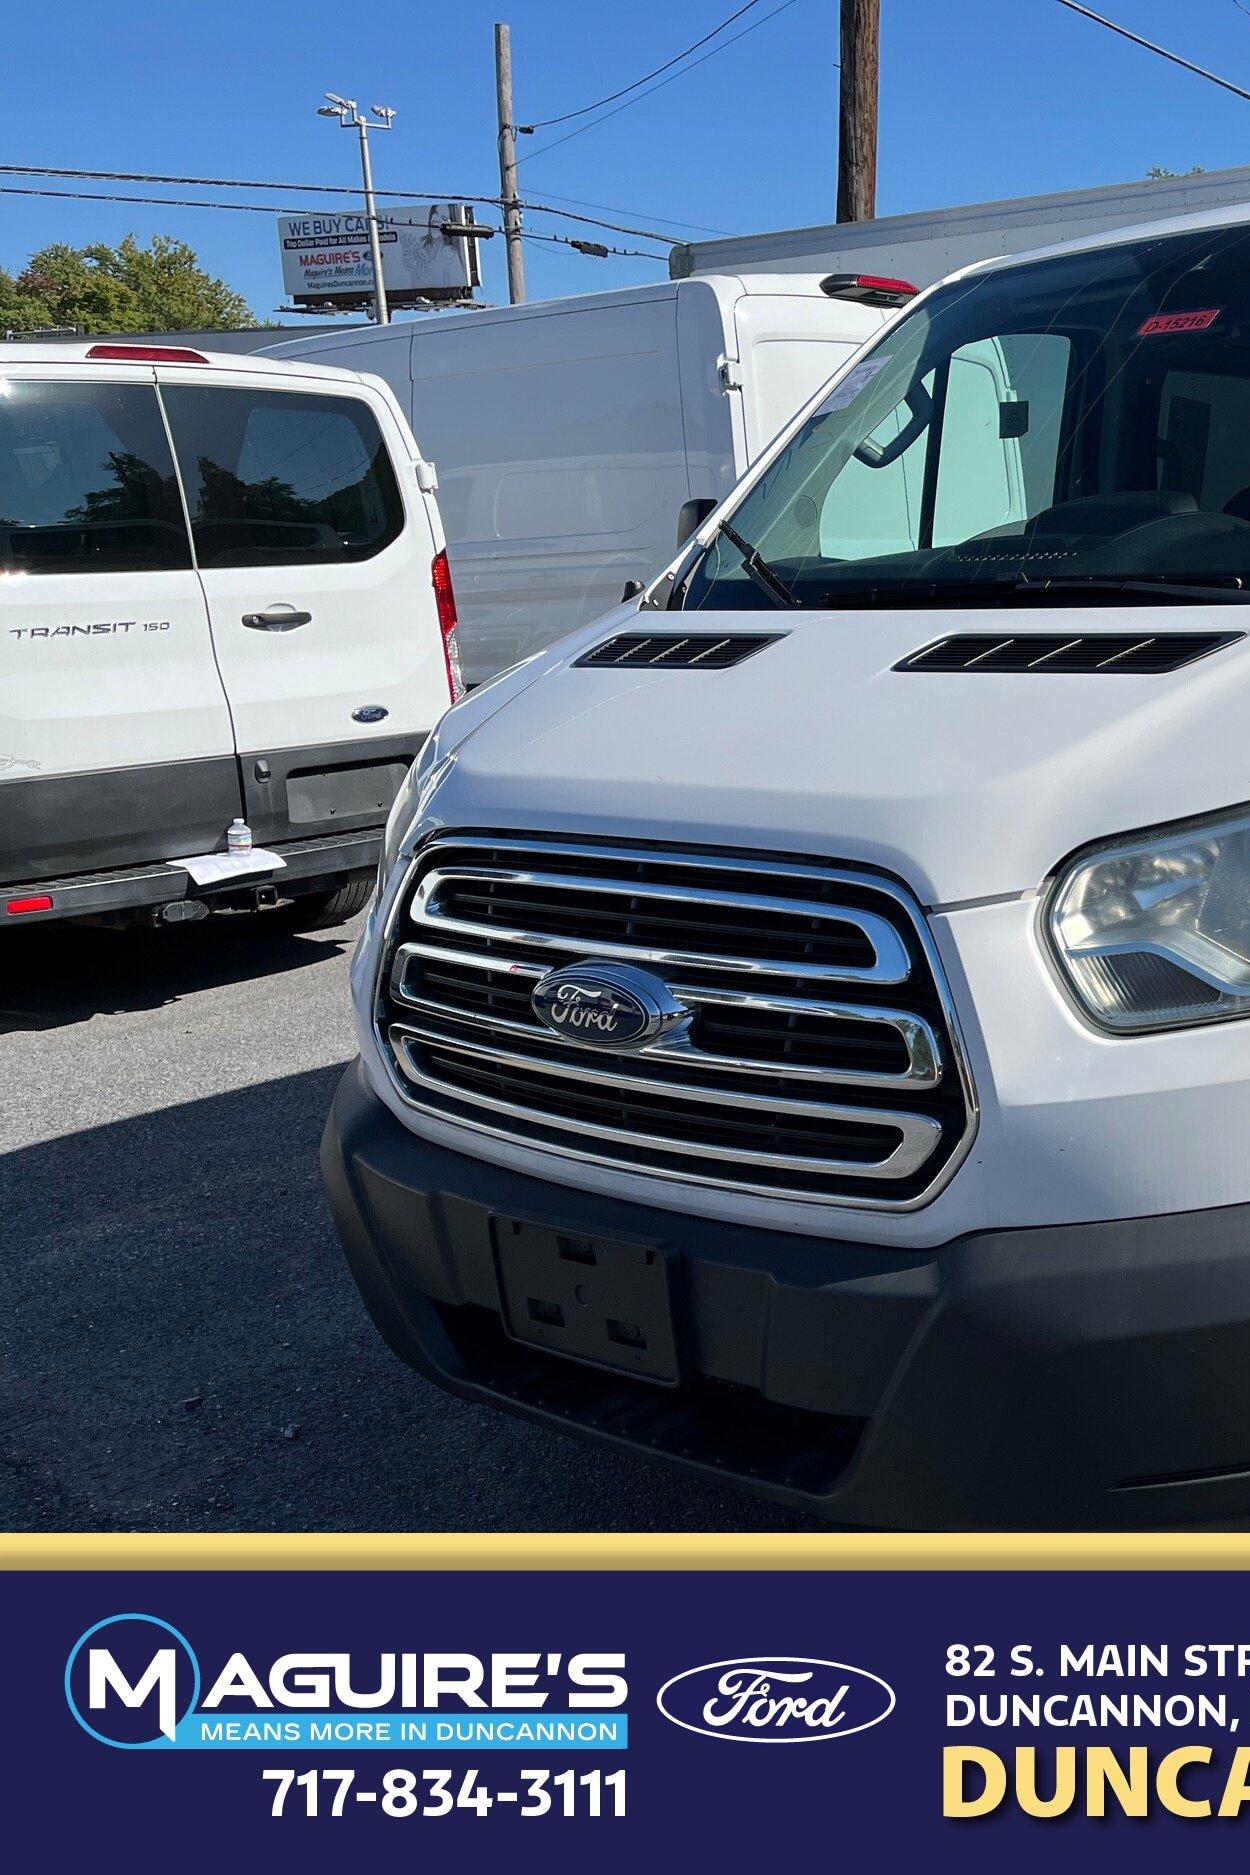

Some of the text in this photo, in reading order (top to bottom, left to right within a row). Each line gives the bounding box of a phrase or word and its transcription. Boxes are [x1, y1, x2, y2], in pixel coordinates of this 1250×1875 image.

[289, 221, 310, 236] WE
[313, 218, 342, 235] BUY
[286, 240, 297, 249] Top
[298, 239, 315, 248] Dollar
[315, 238, 329, 246] Paid
[329, 237, 338, 245] for
[299, 250, 361, 267] MAGUIRE'S
[304, 267, 333, 279] Maguire's
[334, 266, 354, 276] Means
[1144, 314, 1208, 333] D-15216
[8, 621, 170, 640] TRANSIT 150
[551, 984, 619, 1032] Ford
